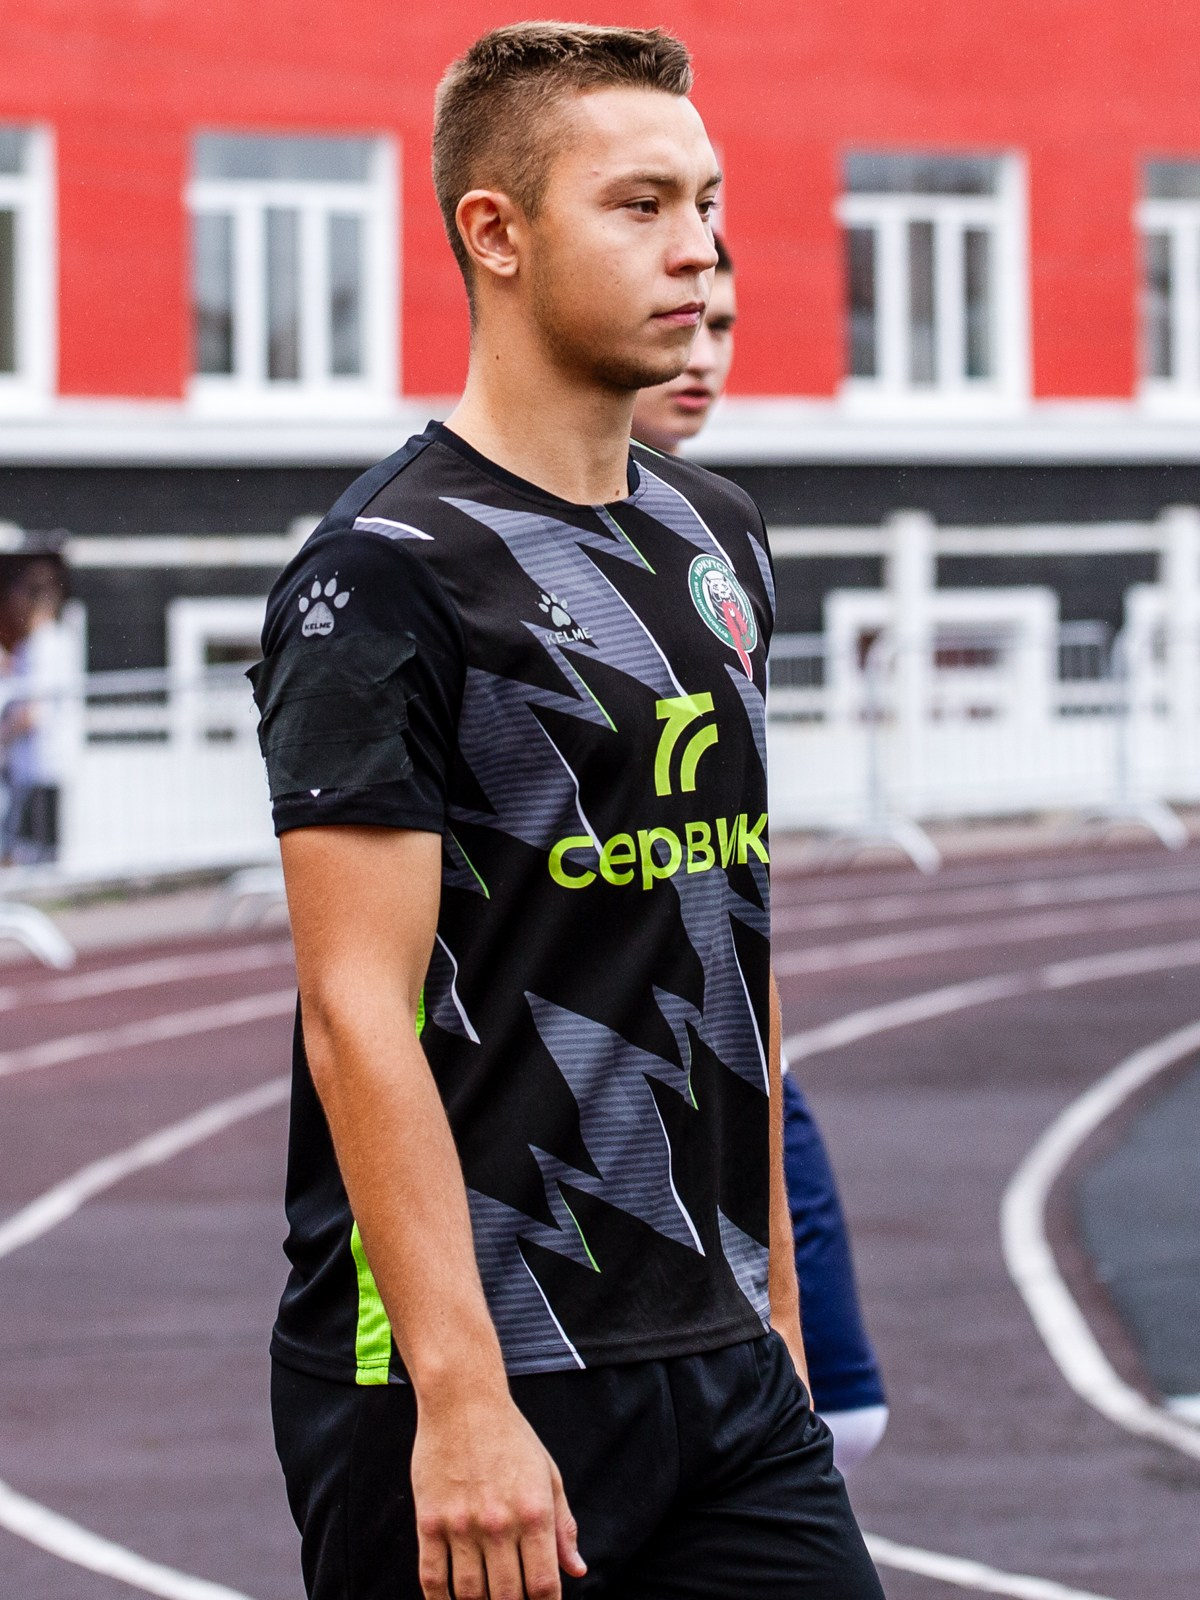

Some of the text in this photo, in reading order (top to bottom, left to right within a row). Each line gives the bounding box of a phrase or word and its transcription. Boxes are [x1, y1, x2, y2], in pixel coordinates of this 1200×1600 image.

[694, 559, 728, 577] ИРКУТСК
[304, 621, 332, 631] KELME
[545, 627, 593, 645] KELME
